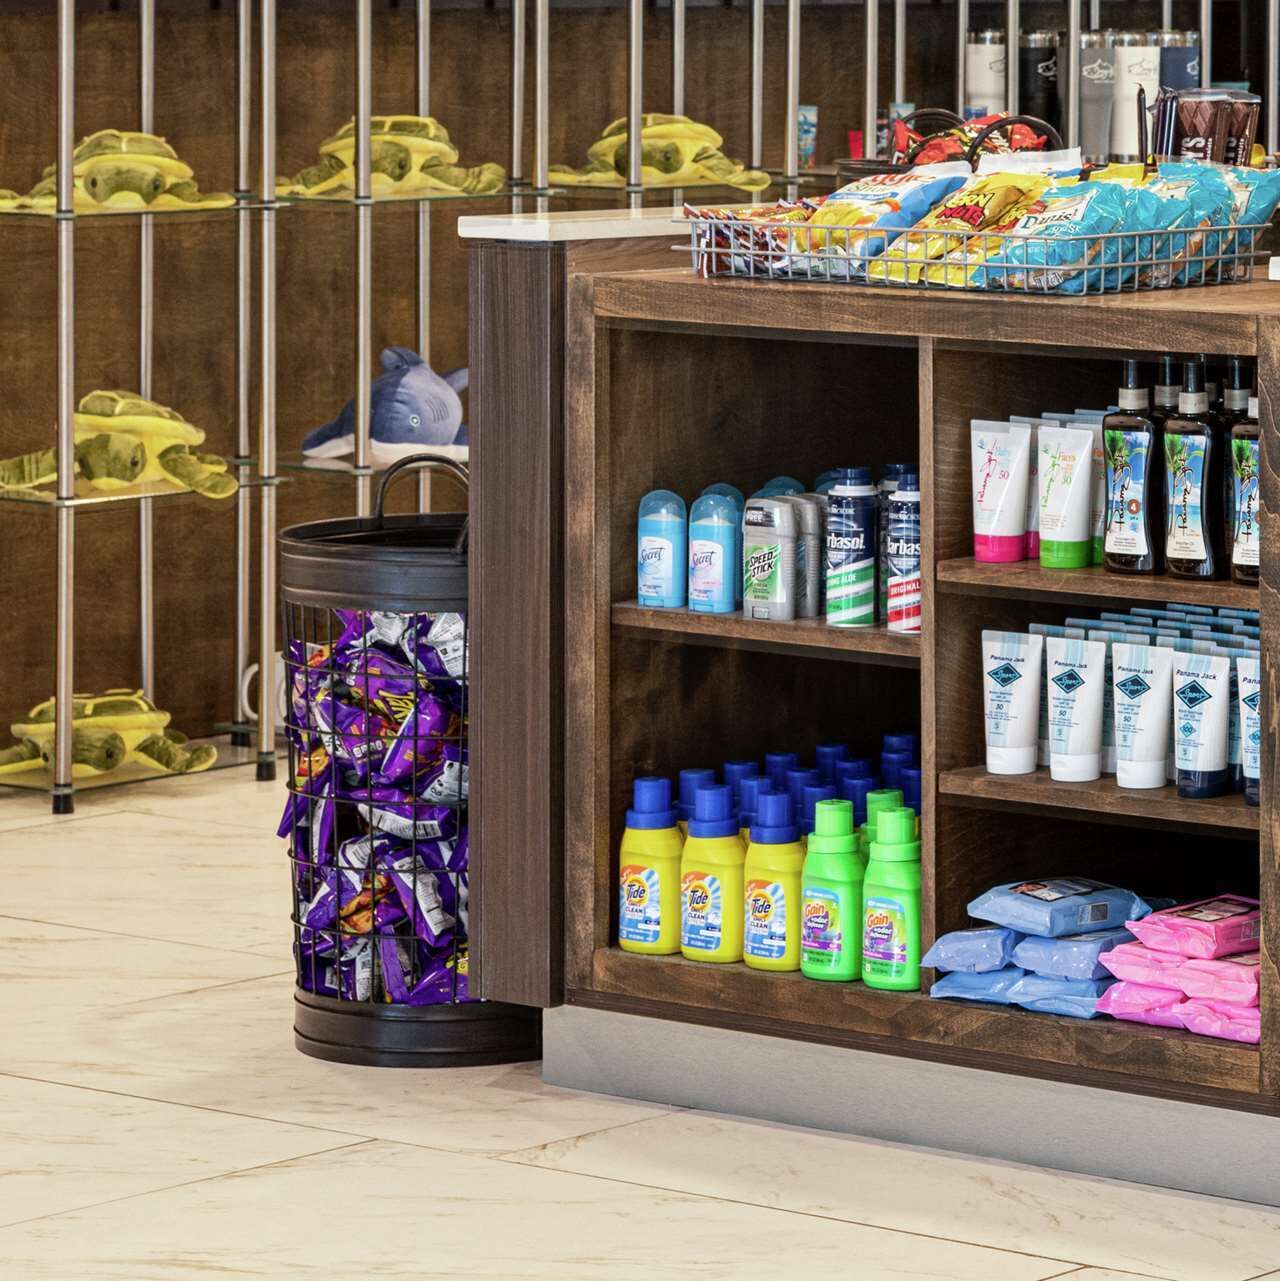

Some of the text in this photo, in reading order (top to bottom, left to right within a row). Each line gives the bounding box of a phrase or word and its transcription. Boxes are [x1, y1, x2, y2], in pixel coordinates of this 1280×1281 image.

[936, 205, 985, 226] NUTS
[640, 547, 665, 563] Secret
[692, 550, 714, 566] Secret
[750, 551, 774, 565] SPEED
[751, 563, 774, 577] STICK
[841, 574, 856, 583] ALOE
[890, 579, 920, 595] ORIGINAL
[1176, 669, 1217, 681] Panama Jack
[627, 883, 645, 899] Tide
[689, 890, 708, 906] Tide
[752, 898, 771, 914] Tide
[805, 903, 825, 917] Gain
[868, 914, 889, 927] Gain
